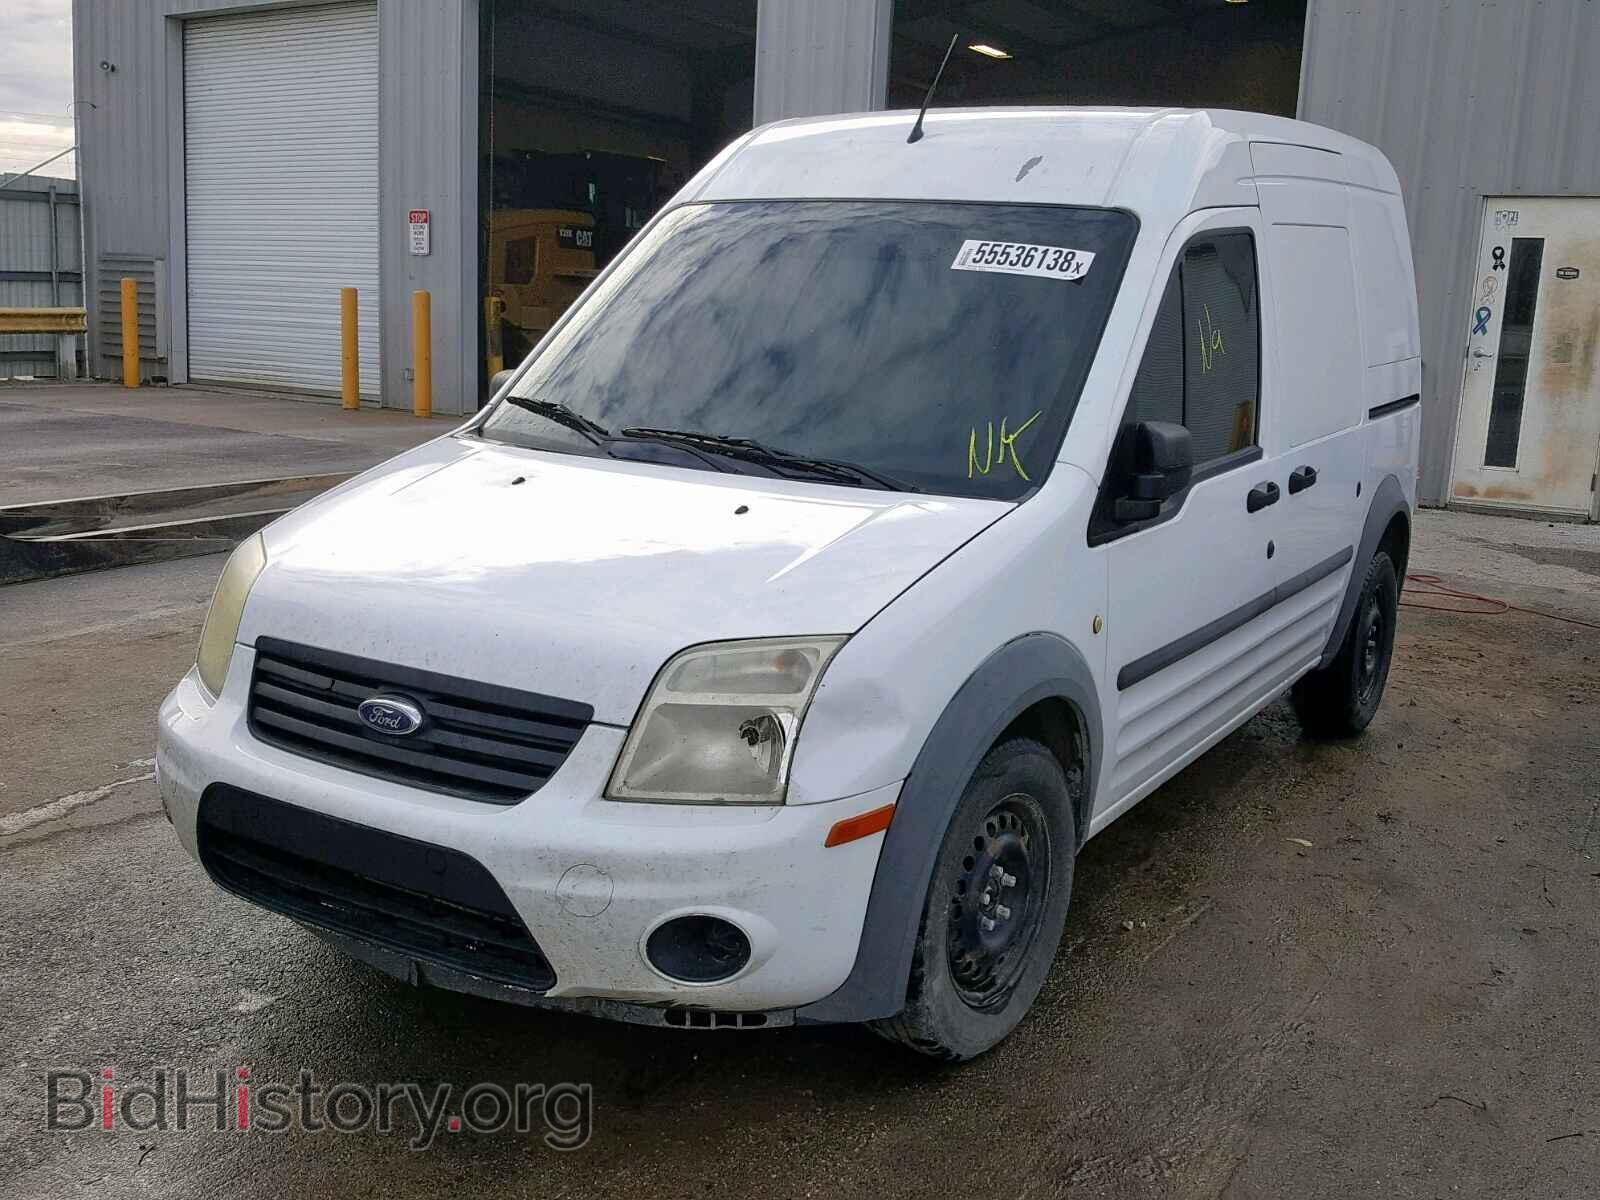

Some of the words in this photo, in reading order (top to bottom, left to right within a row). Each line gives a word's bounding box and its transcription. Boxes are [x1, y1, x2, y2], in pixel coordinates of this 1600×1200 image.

[410, 212, 428, 224] STOP
[576, 230, 592, 247] CAT
[972, 243, 1076, 272] 55536138
[369, 706, 401, 728] Ford
